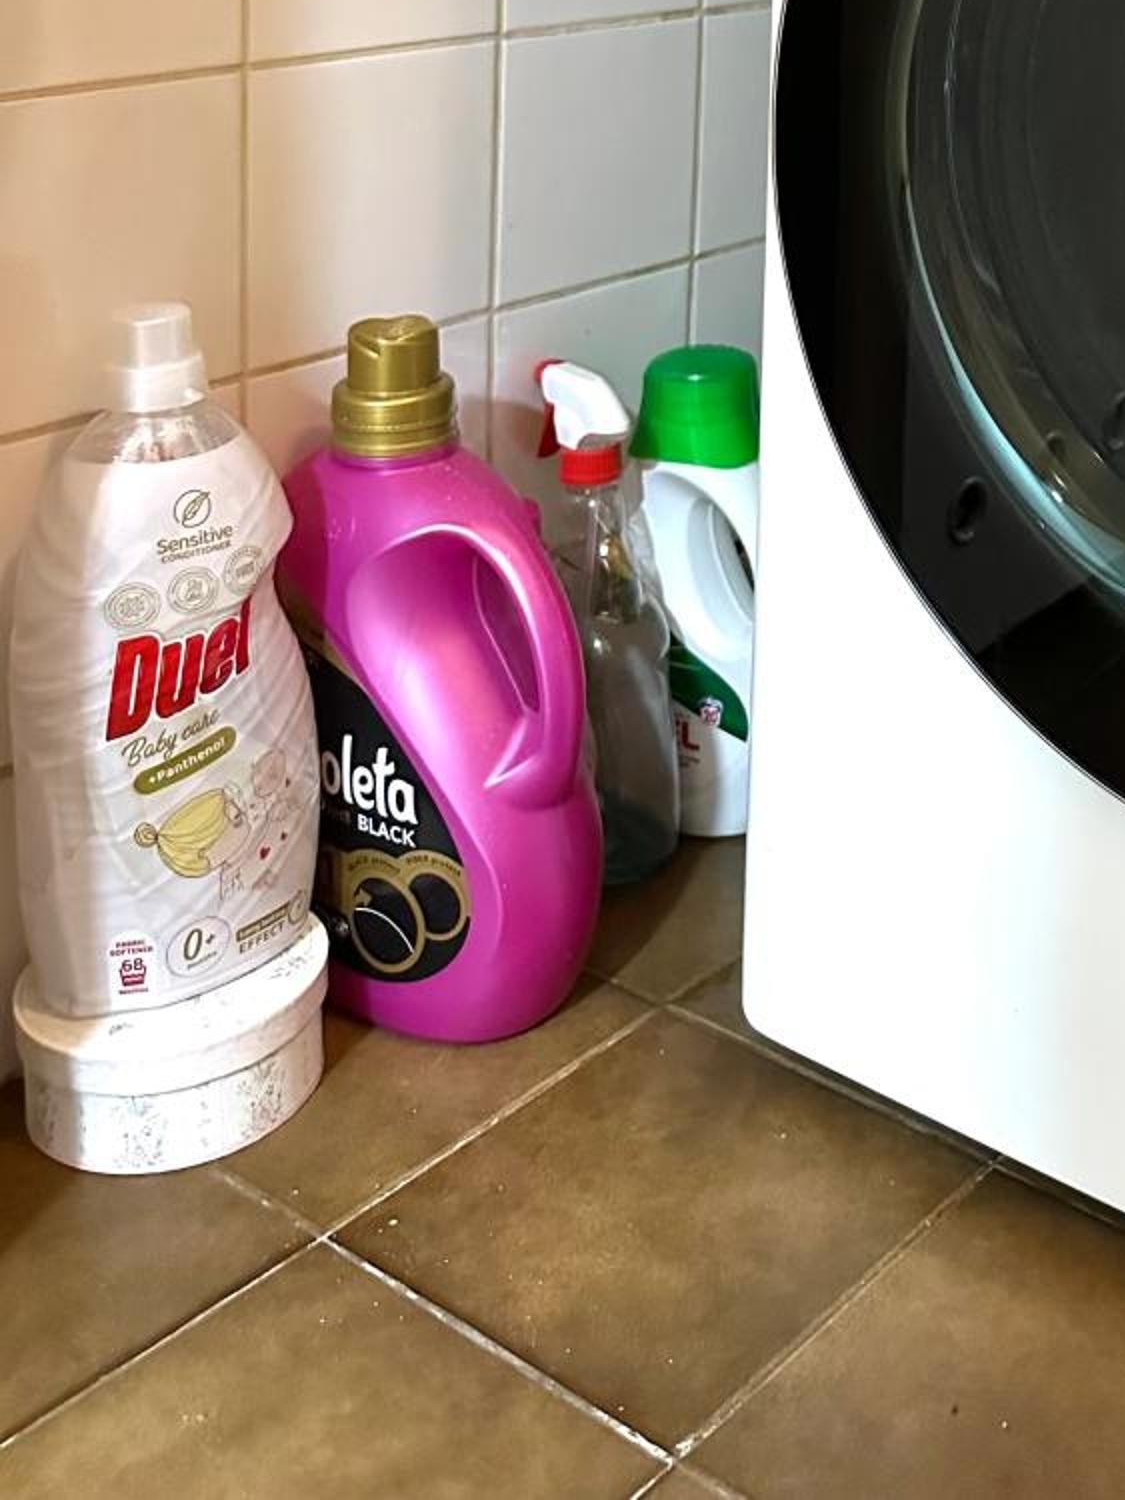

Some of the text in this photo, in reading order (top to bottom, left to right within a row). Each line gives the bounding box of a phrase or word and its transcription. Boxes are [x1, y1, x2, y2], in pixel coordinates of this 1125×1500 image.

[157, 525, 233, 556] Sensitive
[106, 595, 251, 741] Duel
[121, 707, 220, 768] Baby care
[320, 733, 419, 825] oleta
[357, 812, 417, 849] BLACK
[239, 919, 287, 955] EFFECT
[121, 957, 144, 973] 68
